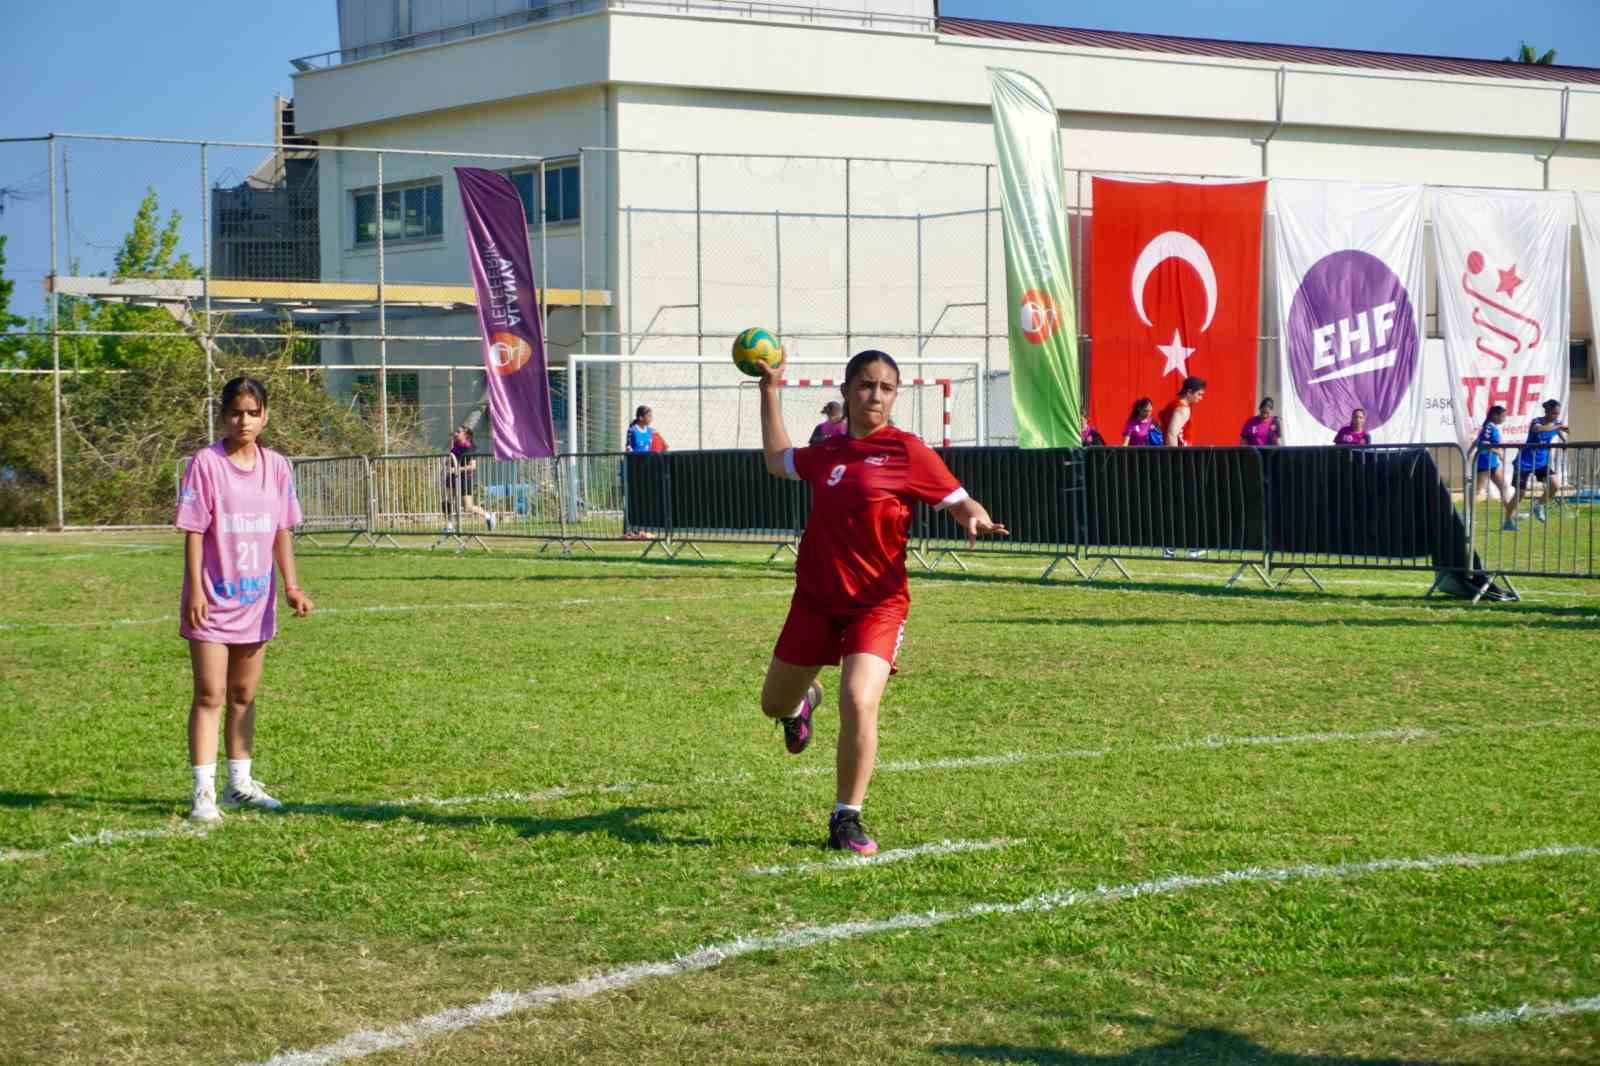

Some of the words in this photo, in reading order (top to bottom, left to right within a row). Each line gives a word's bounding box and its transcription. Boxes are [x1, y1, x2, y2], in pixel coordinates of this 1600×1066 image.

[1312, 301, 1397, 370] EHF
[1461, 375, 1545, 417] THF
[826, 464, 847, 487] 9
[236, 541, 259, 571] 21
